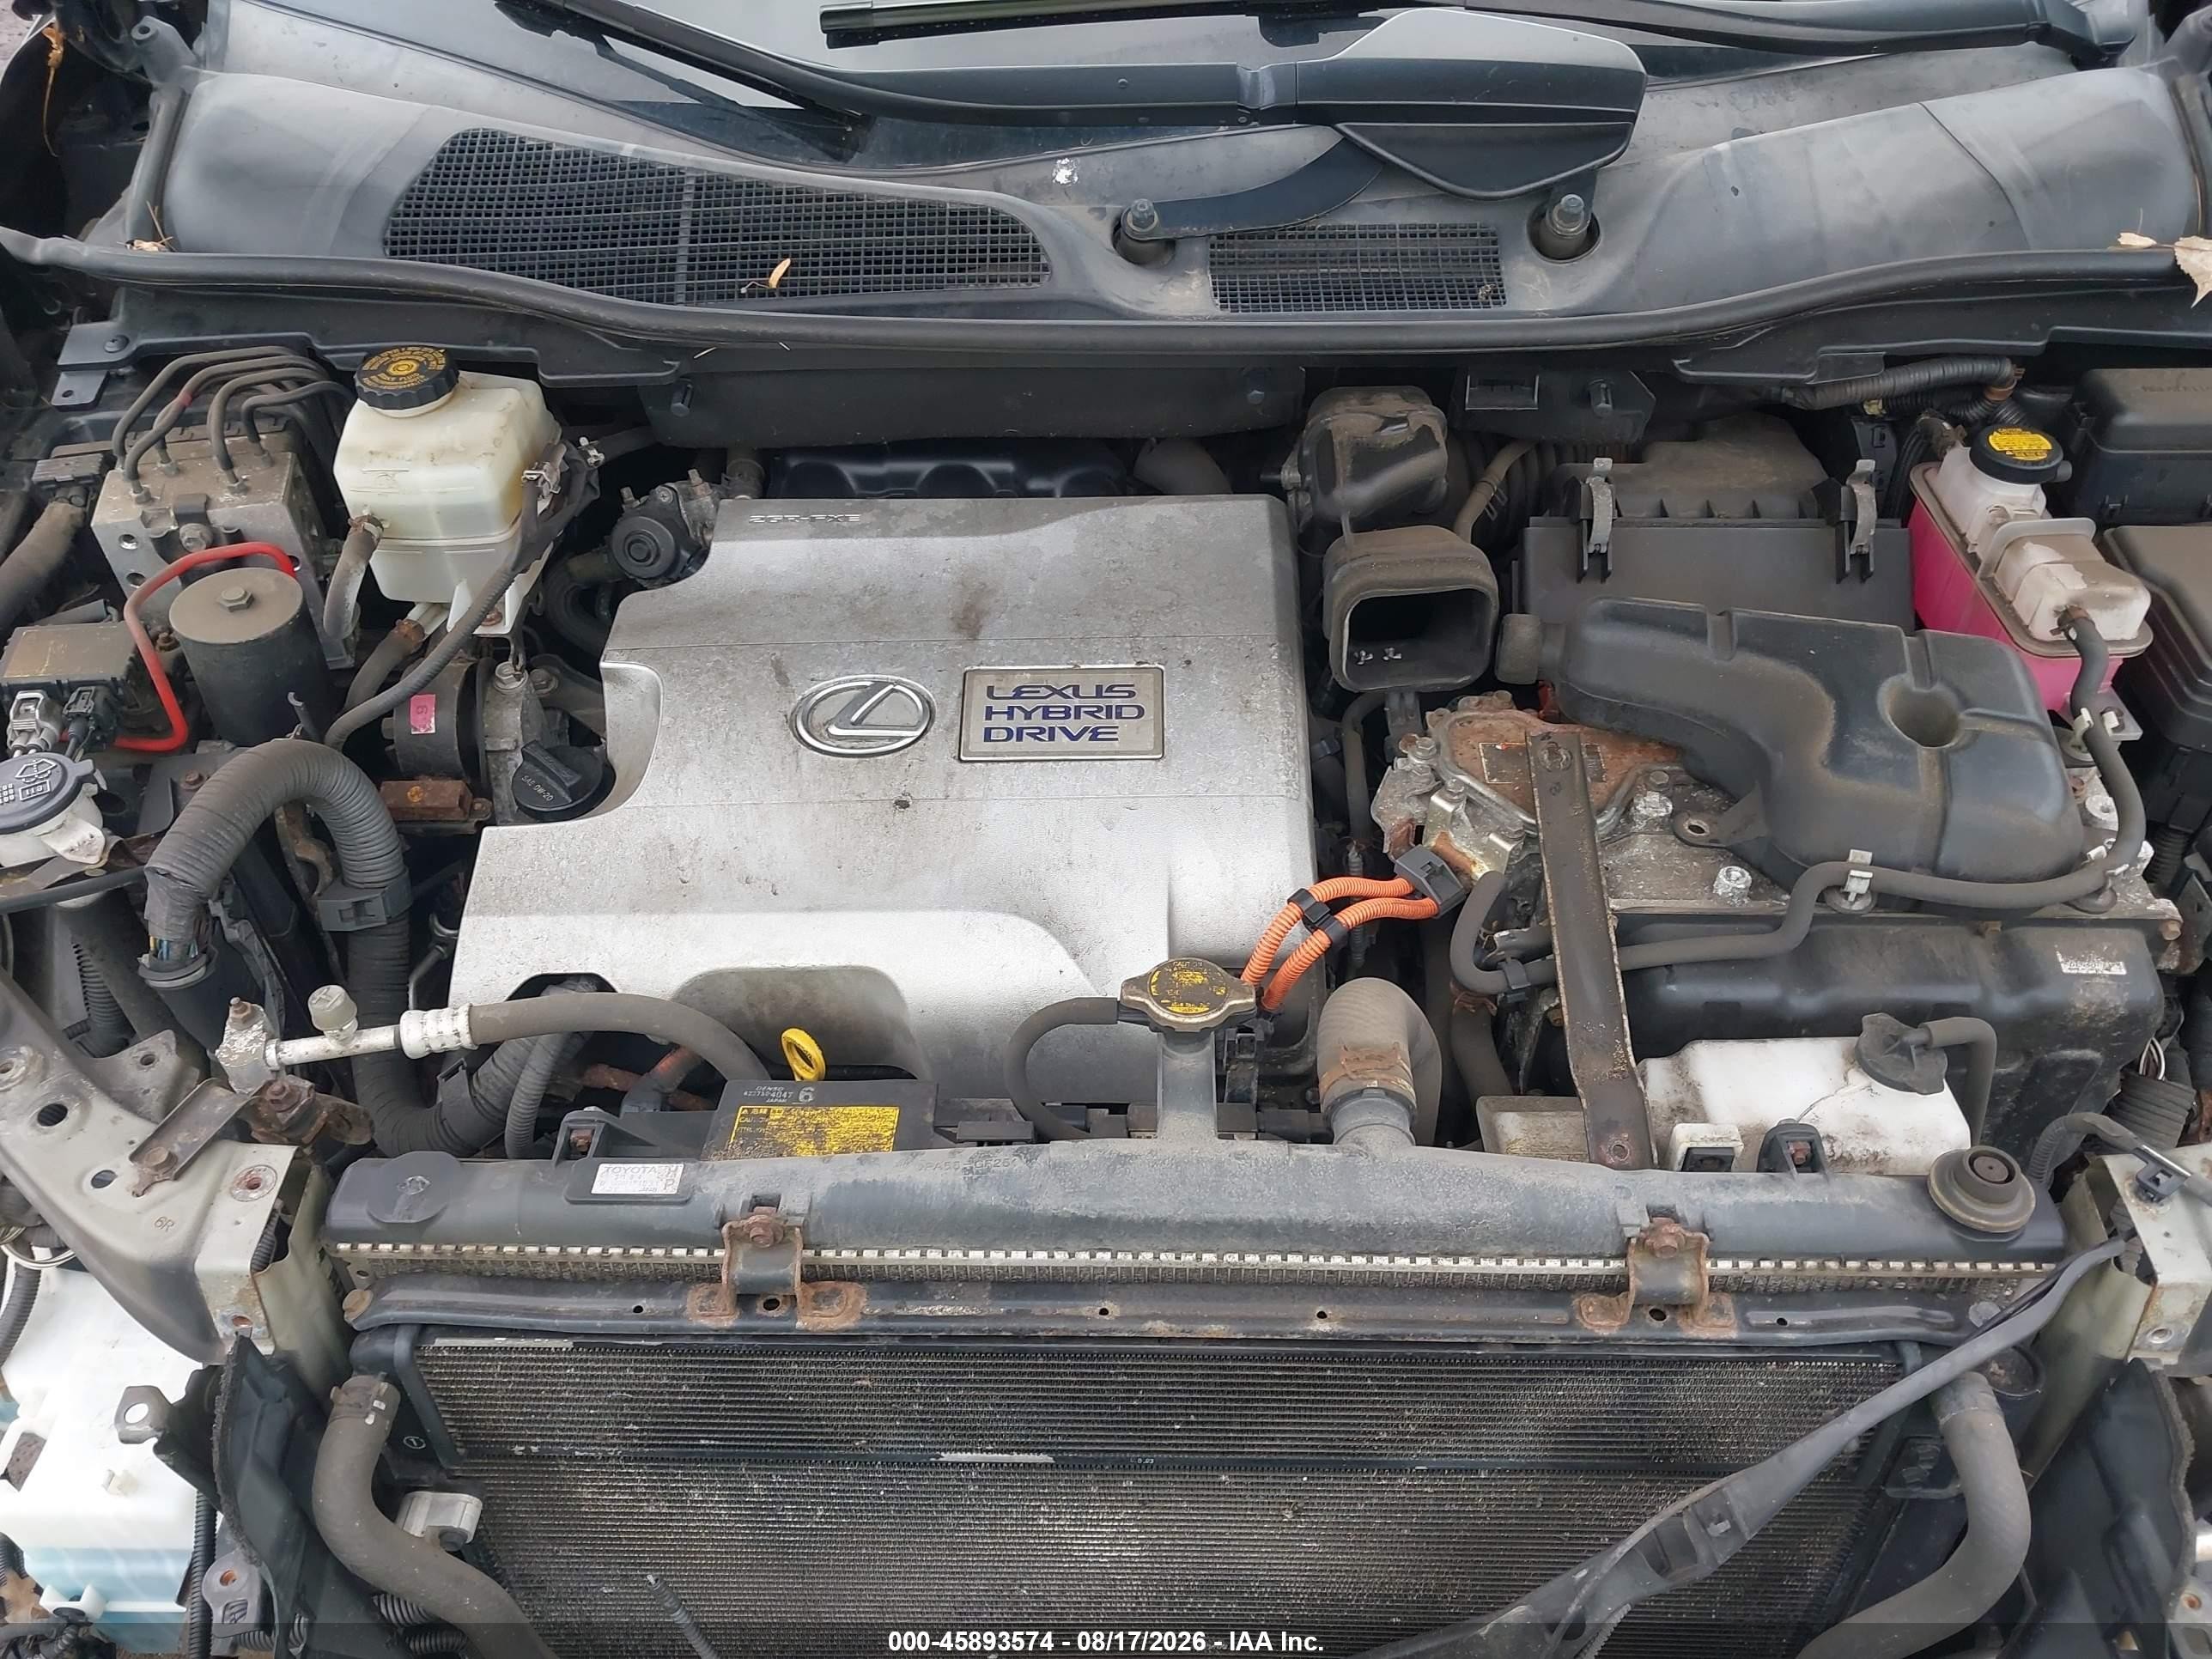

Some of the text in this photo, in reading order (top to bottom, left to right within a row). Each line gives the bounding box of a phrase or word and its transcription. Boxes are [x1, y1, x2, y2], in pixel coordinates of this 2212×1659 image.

[987, 684, 1137, 700] LEXUS
[984, 704, 1146, 721] HYBRID
[983, 725, 1119, 743] DRIVE
[521, 775, 555, 802] SAE 0W-20
[799, 1086, 816, 1103] 6
[604, 1165, 658, 1174] TOYOTA
